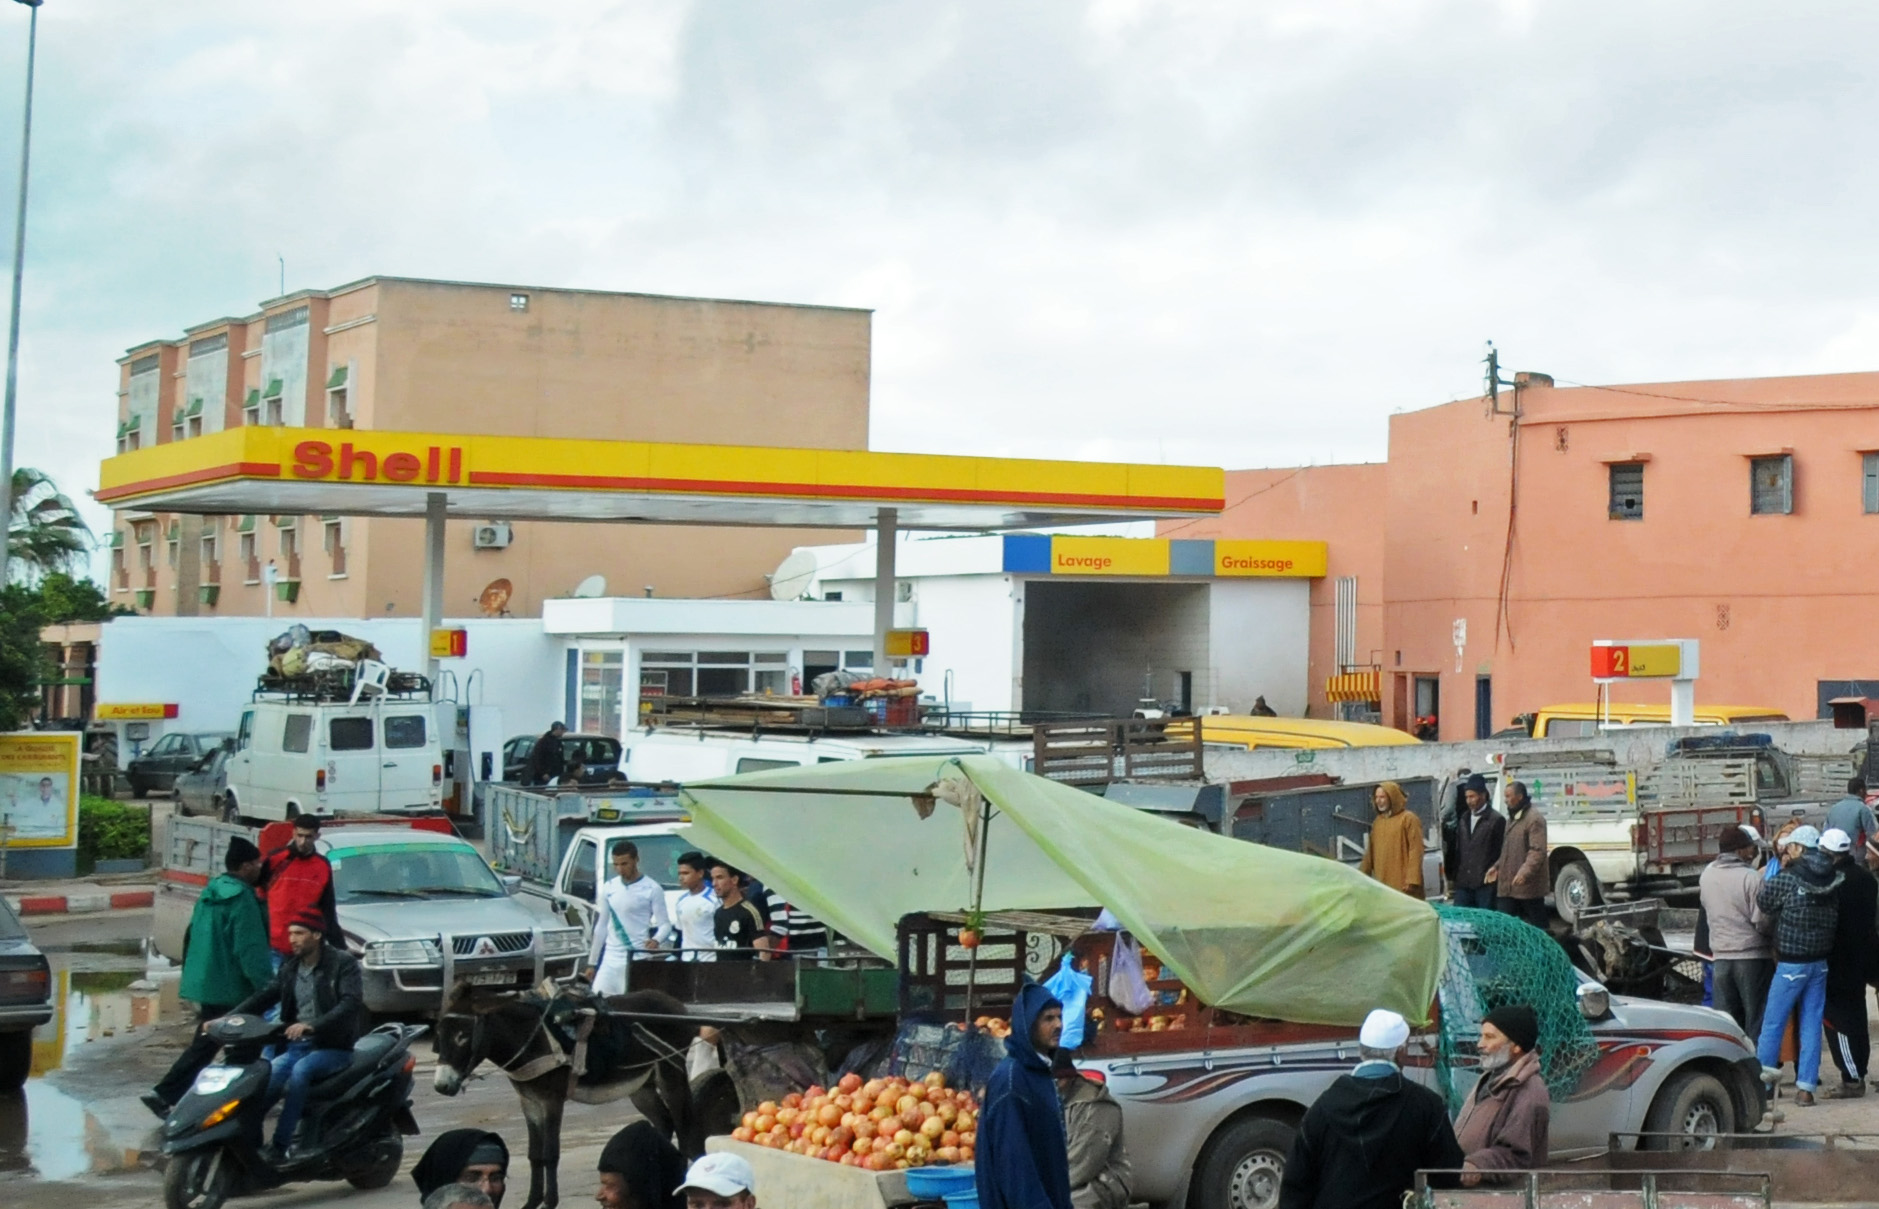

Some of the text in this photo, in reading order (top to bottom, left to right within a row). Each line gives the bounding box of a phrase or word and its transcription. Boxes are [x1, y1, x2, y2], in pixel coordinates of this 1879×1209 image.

[292, 440, 462, 483] Shell
[1057, 554, 1112, 570] Lavage
[1221, 556, 1294, 572] Graissage
[452, 634, 458, 652] 1
[913, 635, 921, 651] 3
[1612, 650, 1625, 672] 2
[112, 706, 161, 715] Air et Eau
